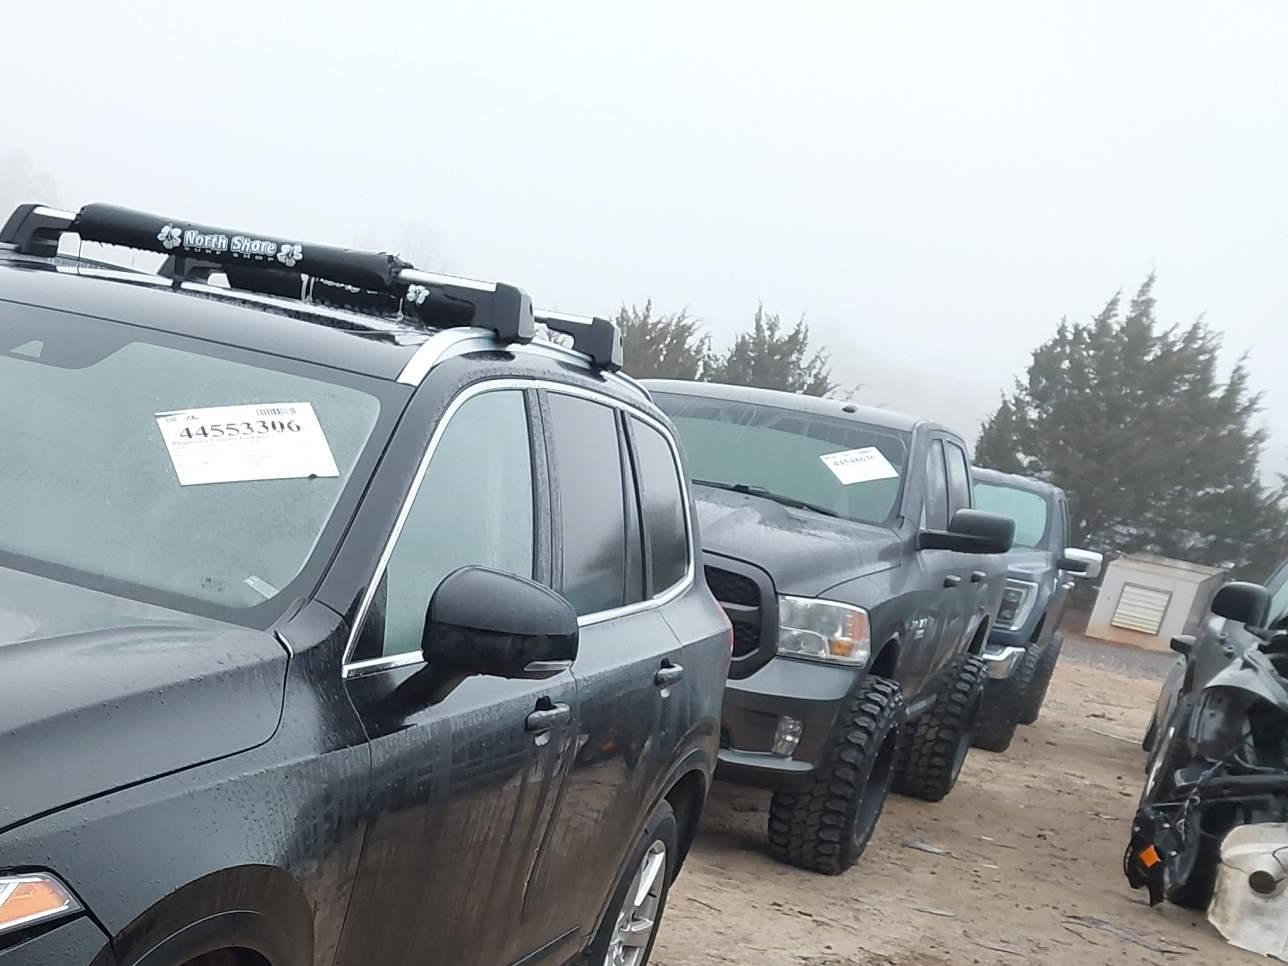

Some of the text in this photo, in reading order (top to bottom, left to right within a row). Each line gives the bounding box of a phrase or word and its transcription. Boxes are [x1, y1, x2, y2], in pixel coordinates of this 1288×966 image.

[183, 230, 277, 256] North Shore
[179, 419, 302, 439] 44553306
